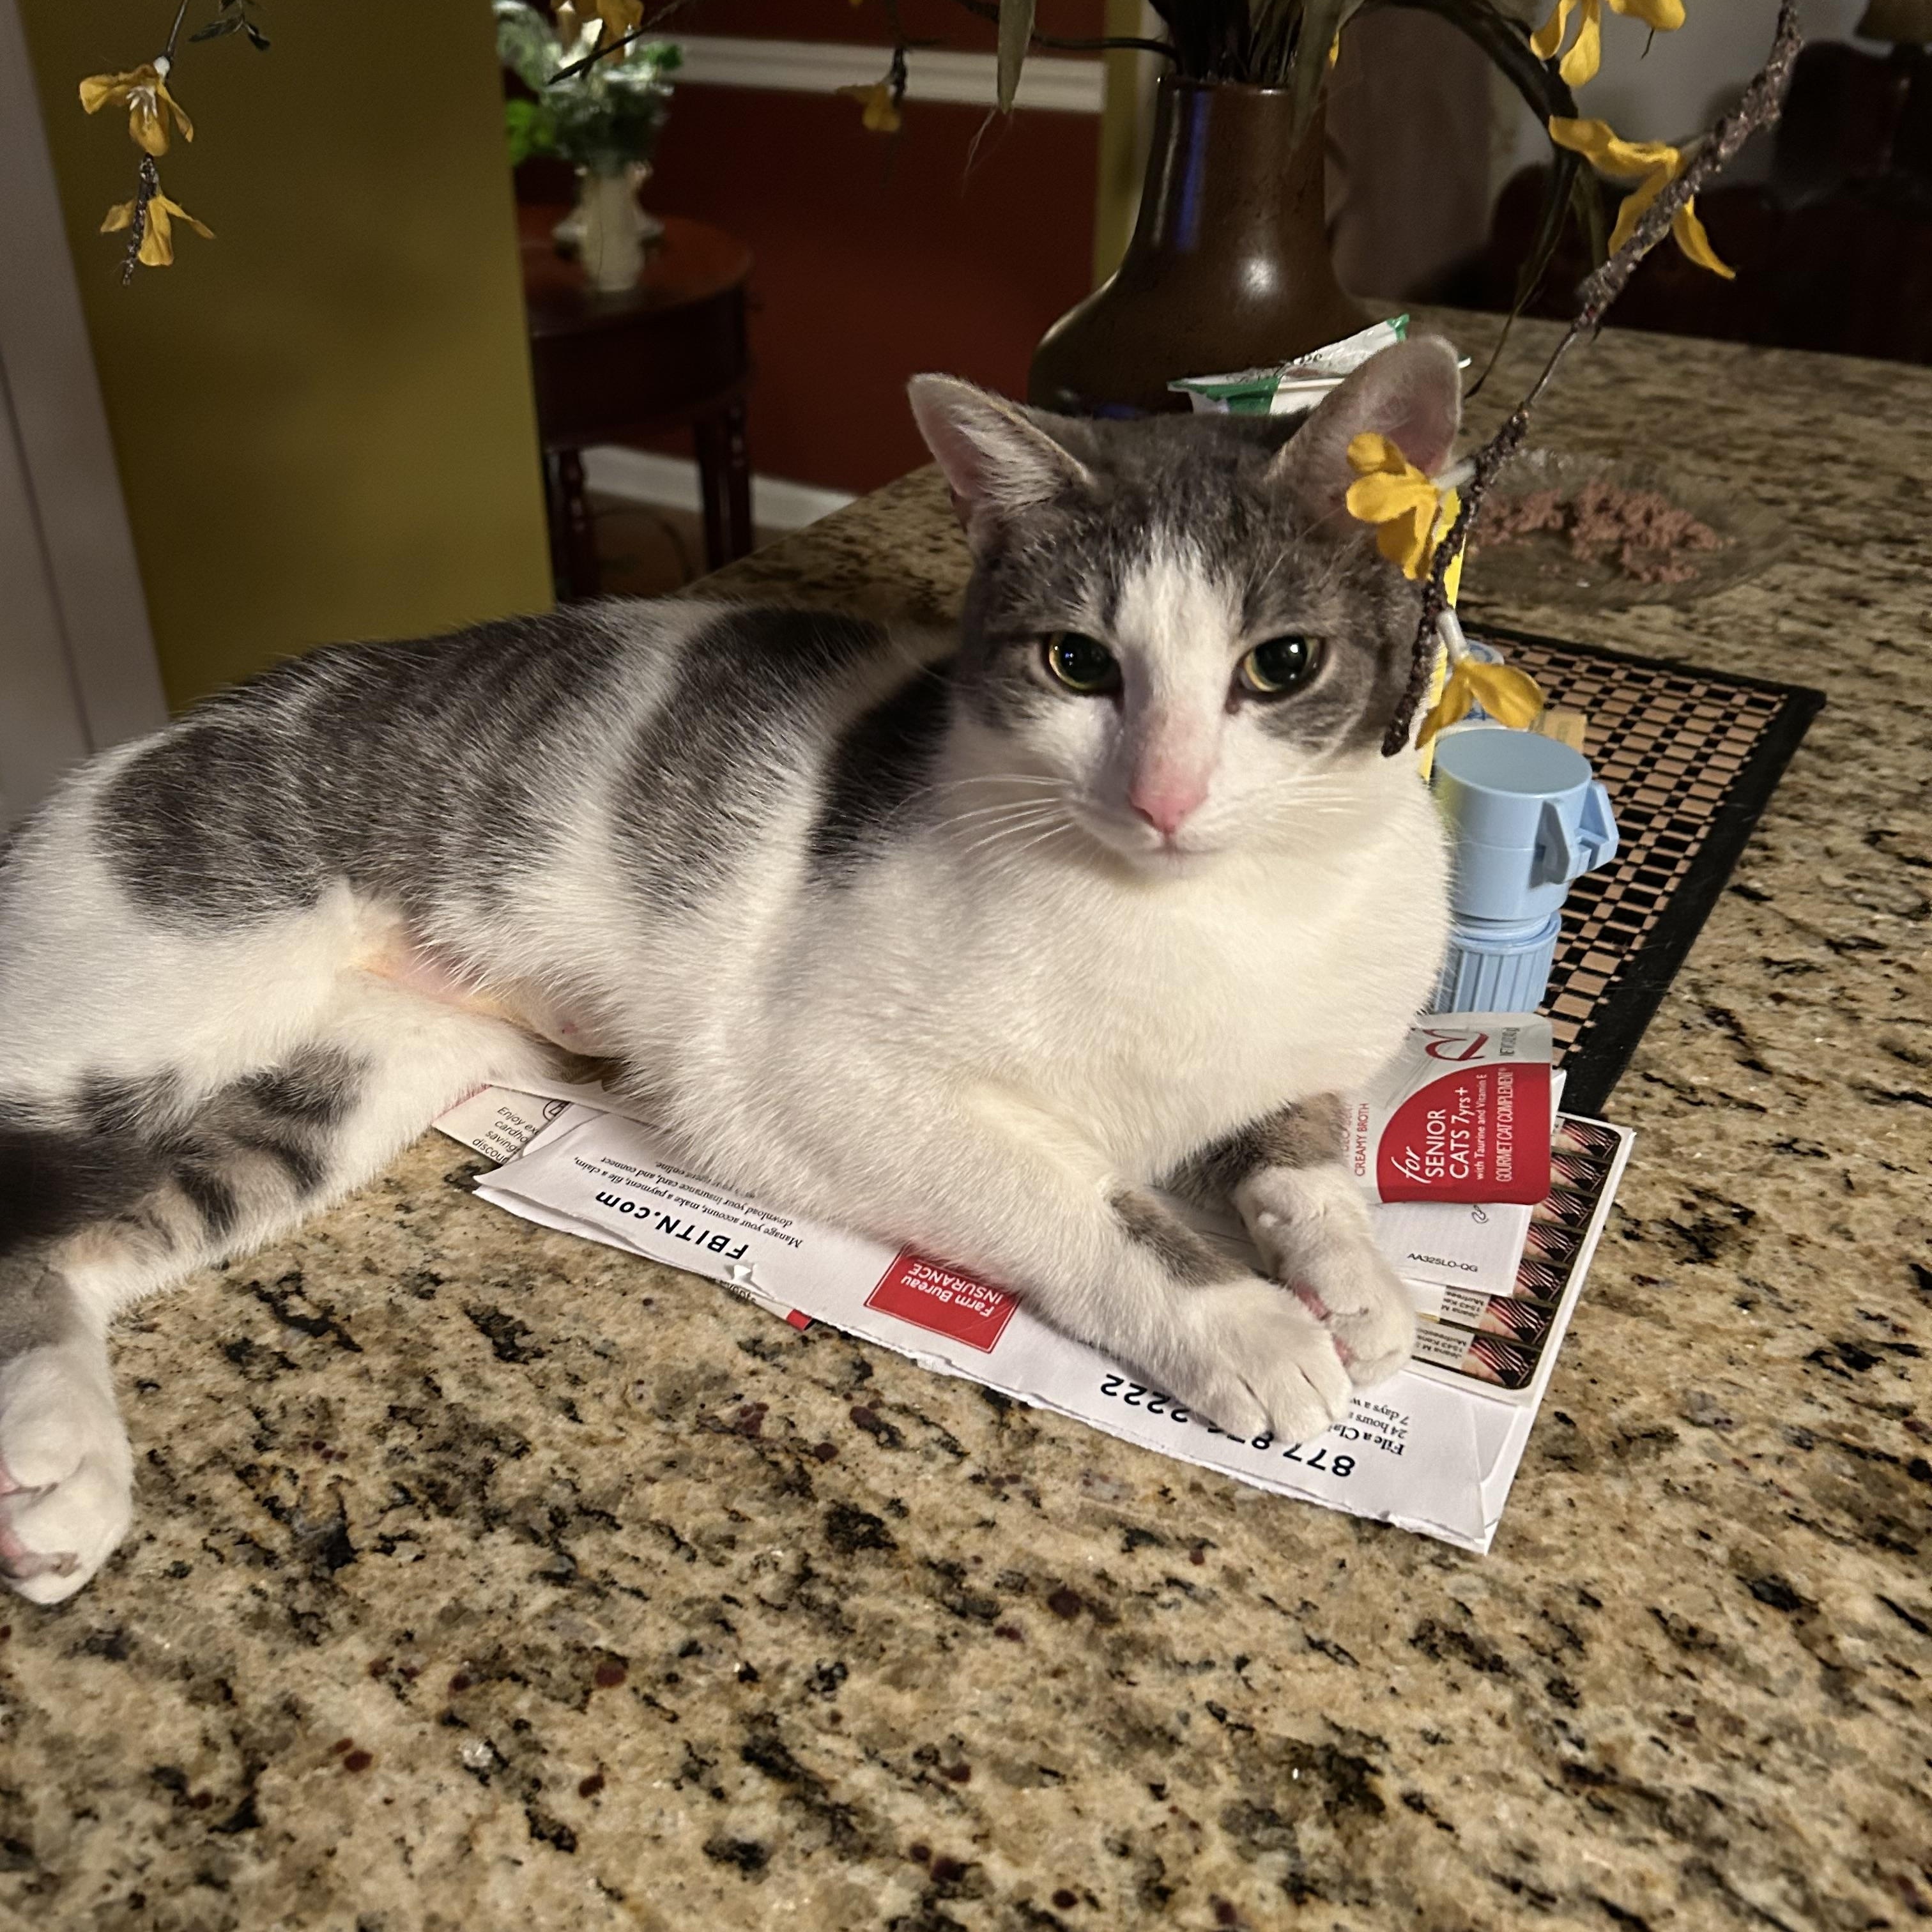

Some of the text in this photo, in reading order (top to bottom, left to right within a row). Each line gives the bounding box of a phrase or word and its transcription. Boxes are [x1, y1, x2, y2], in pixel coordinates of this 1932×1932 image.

[1476, 1080, 1487, 1108] Vitamin
[497, 1107, 526, 1125] Enjoy
[1477, 1110, 1486, 1124] and
[1496, 1119, 1513, 1140] CAT
[1355, 1103, 1369, 1177] CREAMY BROTH
[1425, 1108, 1446, 1177] SENIOR
[1474, 1128, 1486, 1159] Taurine
[1449, 1130, 1470, 1179] CATS
[1496, 1139, 1512, 1183] GOURMET
[574, 1156, 601, 1174] claim,
[601, 1156, 637, 1173] connect
[635, 1169, 656, 1179] and
[1391, 1146, 1432, 1184] for
[1474, 1162, 1485, 1181] with
[608, 1174, 624, 1185] file
[625, 1177, 669, 1197] payment,
[656, 1174, 678, 1188] card,
[674, 1196, 700, 1210] make
[678, 1184, 723, 1205] insurance
[702, 1204, 739, 1223] account,
[723, 1199, 747, 1211] your
[595, 1191, 749, 1260] FBITN.com
[739, 1220, 765, 1232] your
[744, 1207, 793, 1228] download
[763, 1227, 803, 1248] Manage
[908, 1263, 1004, 1305] INSURANCE
[900, 1275, 995, 1317] Farm Bureau
[1372, 1404, 1400, 1420] days
[1400, 1416, 1409, 1425] 7
[1100, 1374, 1356, 1477] 877 2222
[1356, 1414, 1390, 1434] hours
[1391, 1426, 1408, 1439] 24
[1363, 1432, 1372, 1441] a
[1374, 1436, 1405, 1455] File
